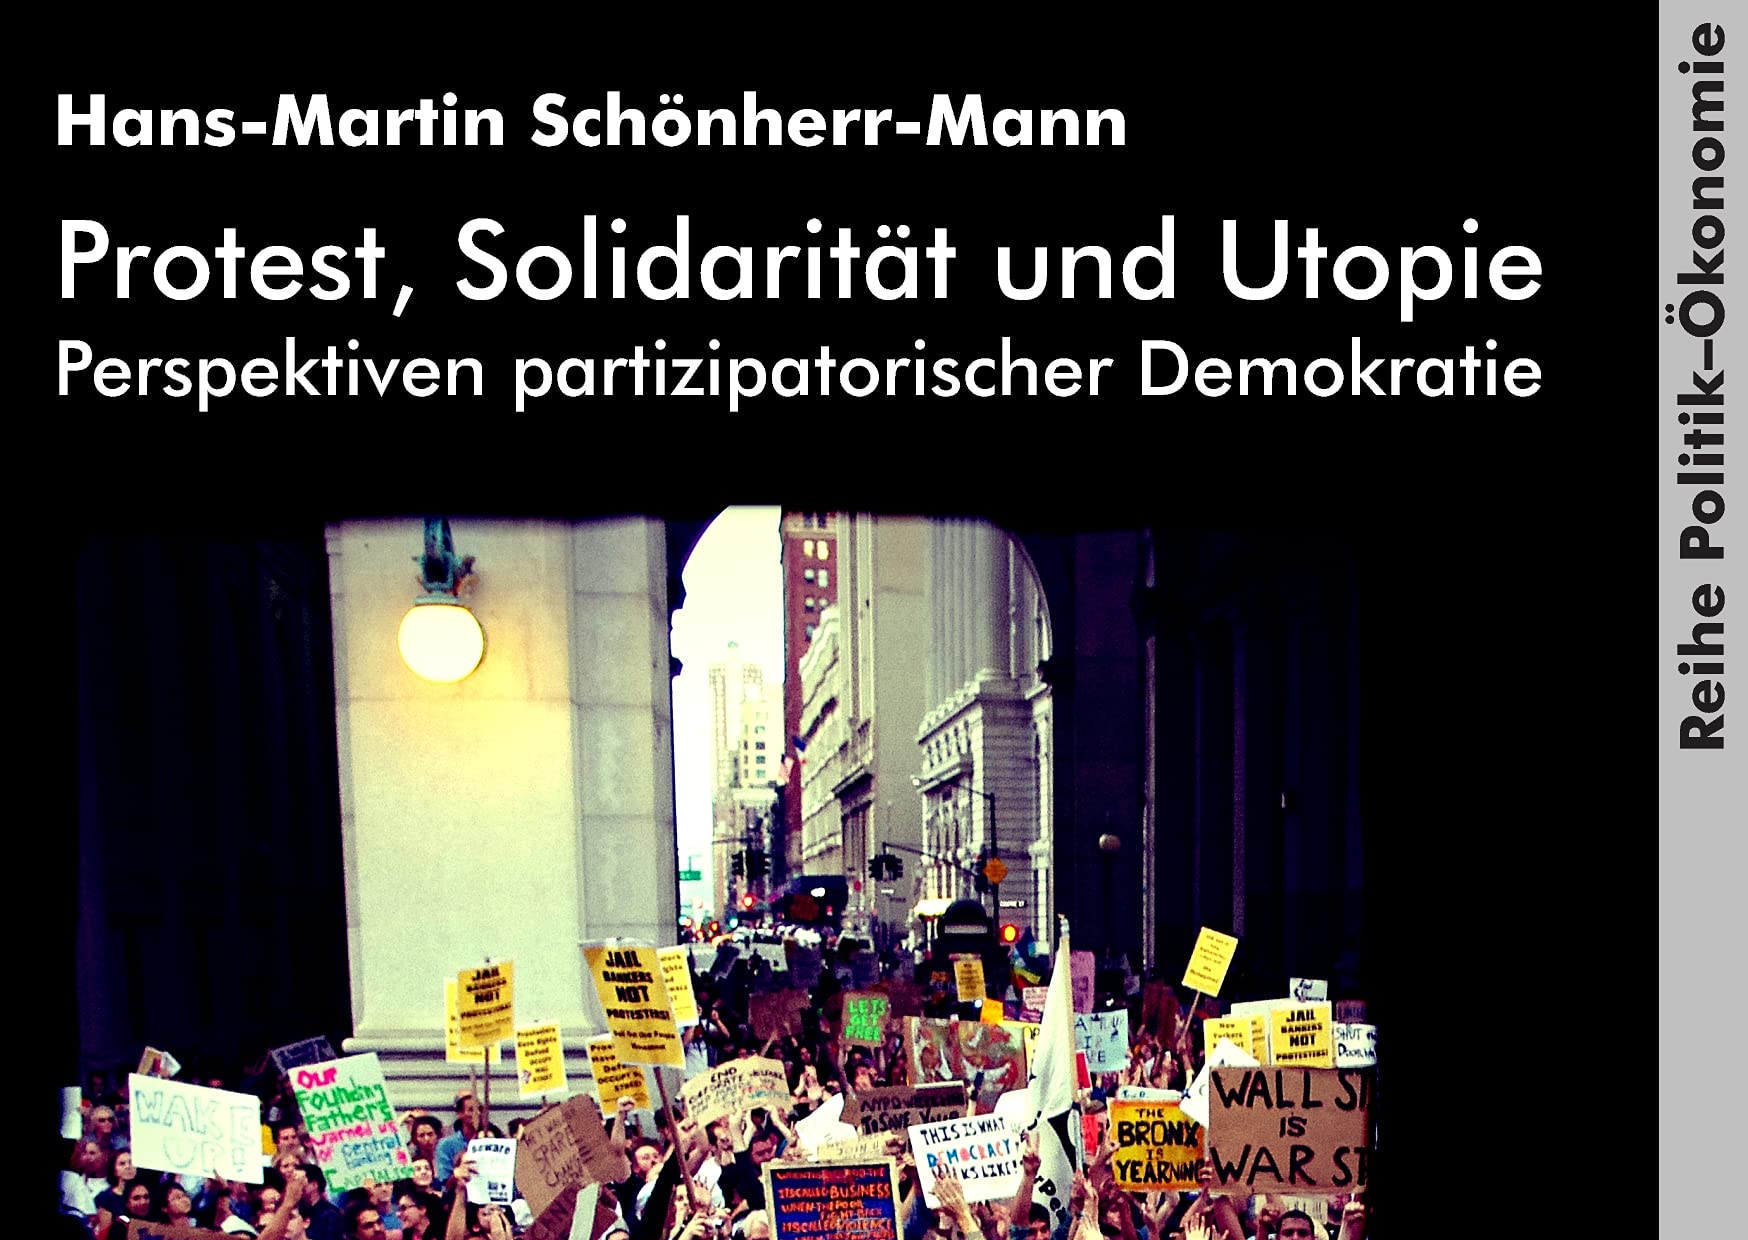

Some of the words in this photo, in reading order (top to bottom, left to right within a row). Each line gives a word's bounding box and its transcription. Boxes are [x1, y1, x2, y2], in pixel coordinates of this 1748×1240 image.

[605, 951, 642, 968] JAIL
[615, 986, 650, 1003] NOT
[1286, 1009, 1315, 1022] JAIL
[1289, 1034, 1316, 1047] NOT
[1211, 1070, 1323, 1109] WALL
[135, 1089, 256, 1147] WAKE
[1135, 1108, 1165, 1118] THE
[920, 1124, 960, 1146] THIS
[962, 1122, 977, 1137] IS
[977, 1116, 1006, 1134] WHAT
[1117, 1121, 1201, 1149] BRONX
[1279, 1115, 1308, 1138] IS
[163, 1136, 246, 1173] UP!
[926, 1138, 1011, 1169] DEMOCRACY
[1209, 1144, 1316, 1186] WAR
[1332, 1146, 1371, 1187] ST
[829, 1183, 891, 1199] BUSINESS
